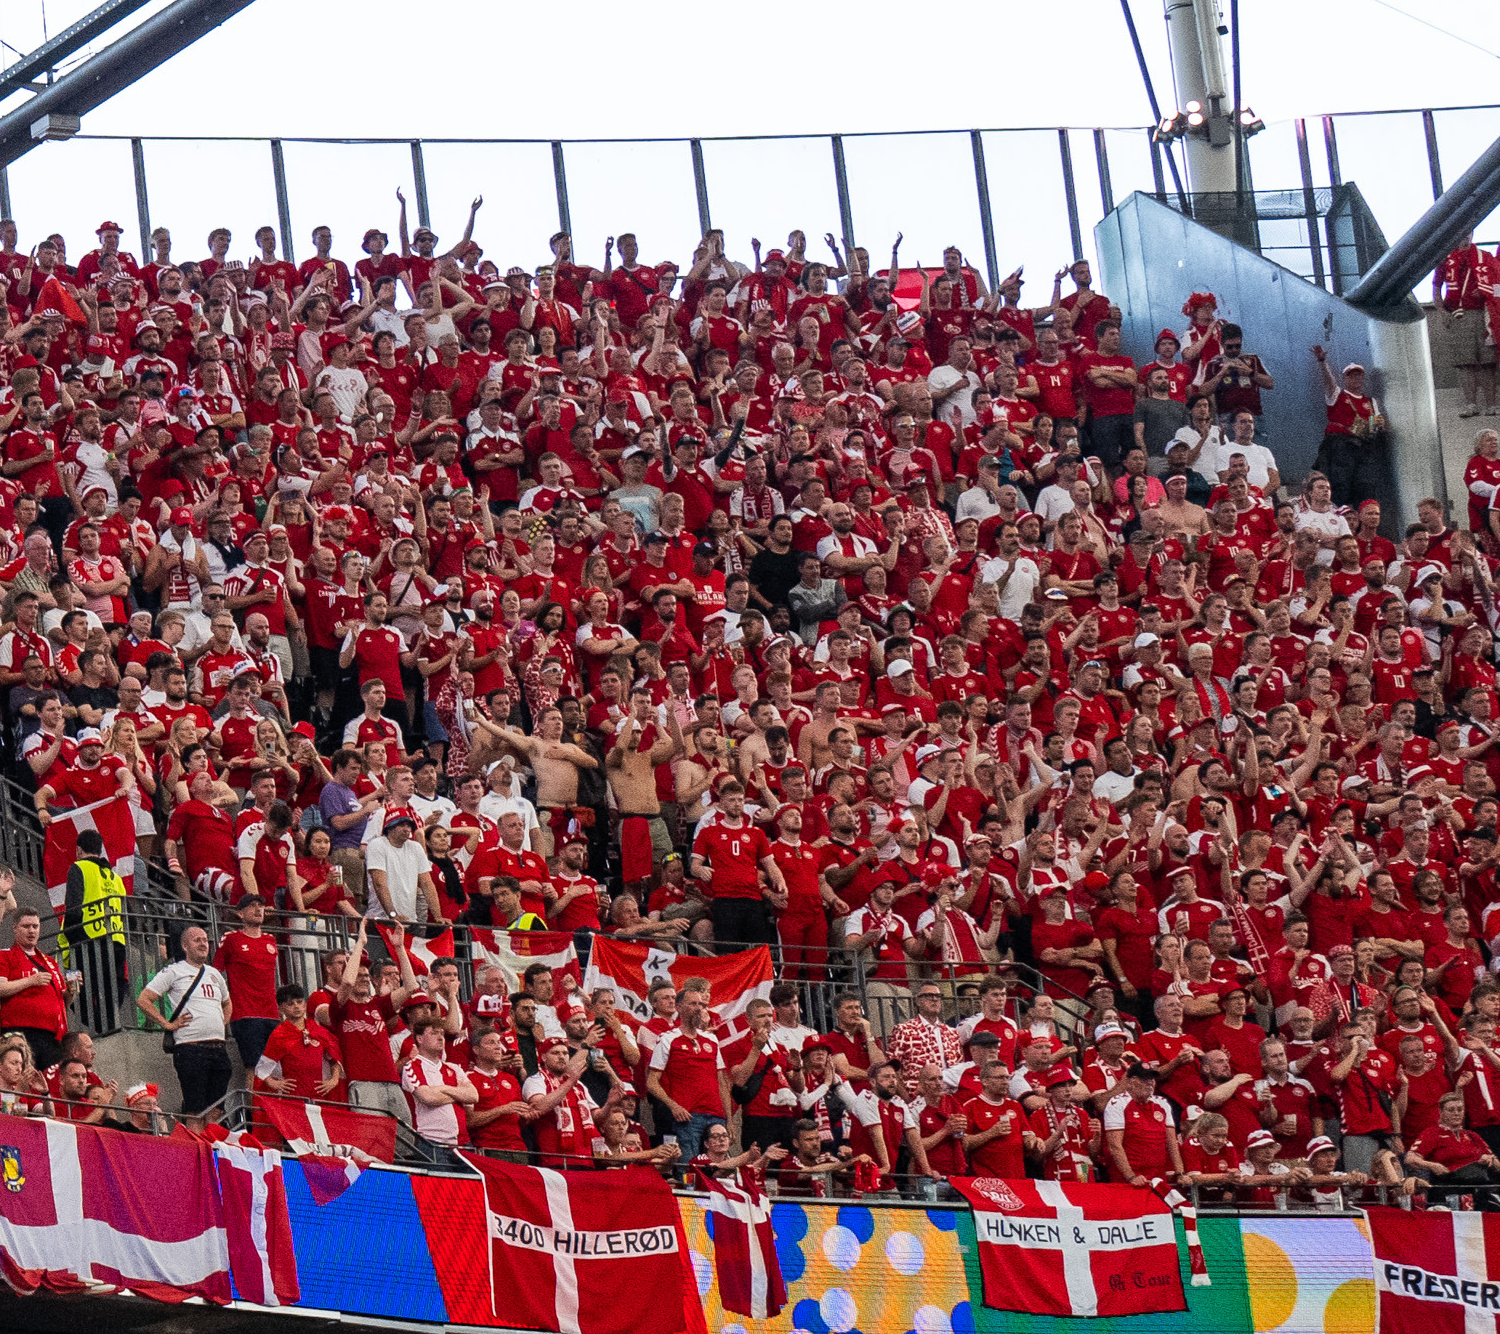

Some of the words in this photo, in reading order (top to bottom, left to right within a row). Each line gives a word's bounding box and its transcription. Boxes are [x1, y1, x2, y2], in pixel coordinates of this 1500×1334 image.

[494, 1216, 545, 1249] 3400
[553, 1225, 675, 1255] HILLERØD
[1074, 1226, 1087, 1244] &
